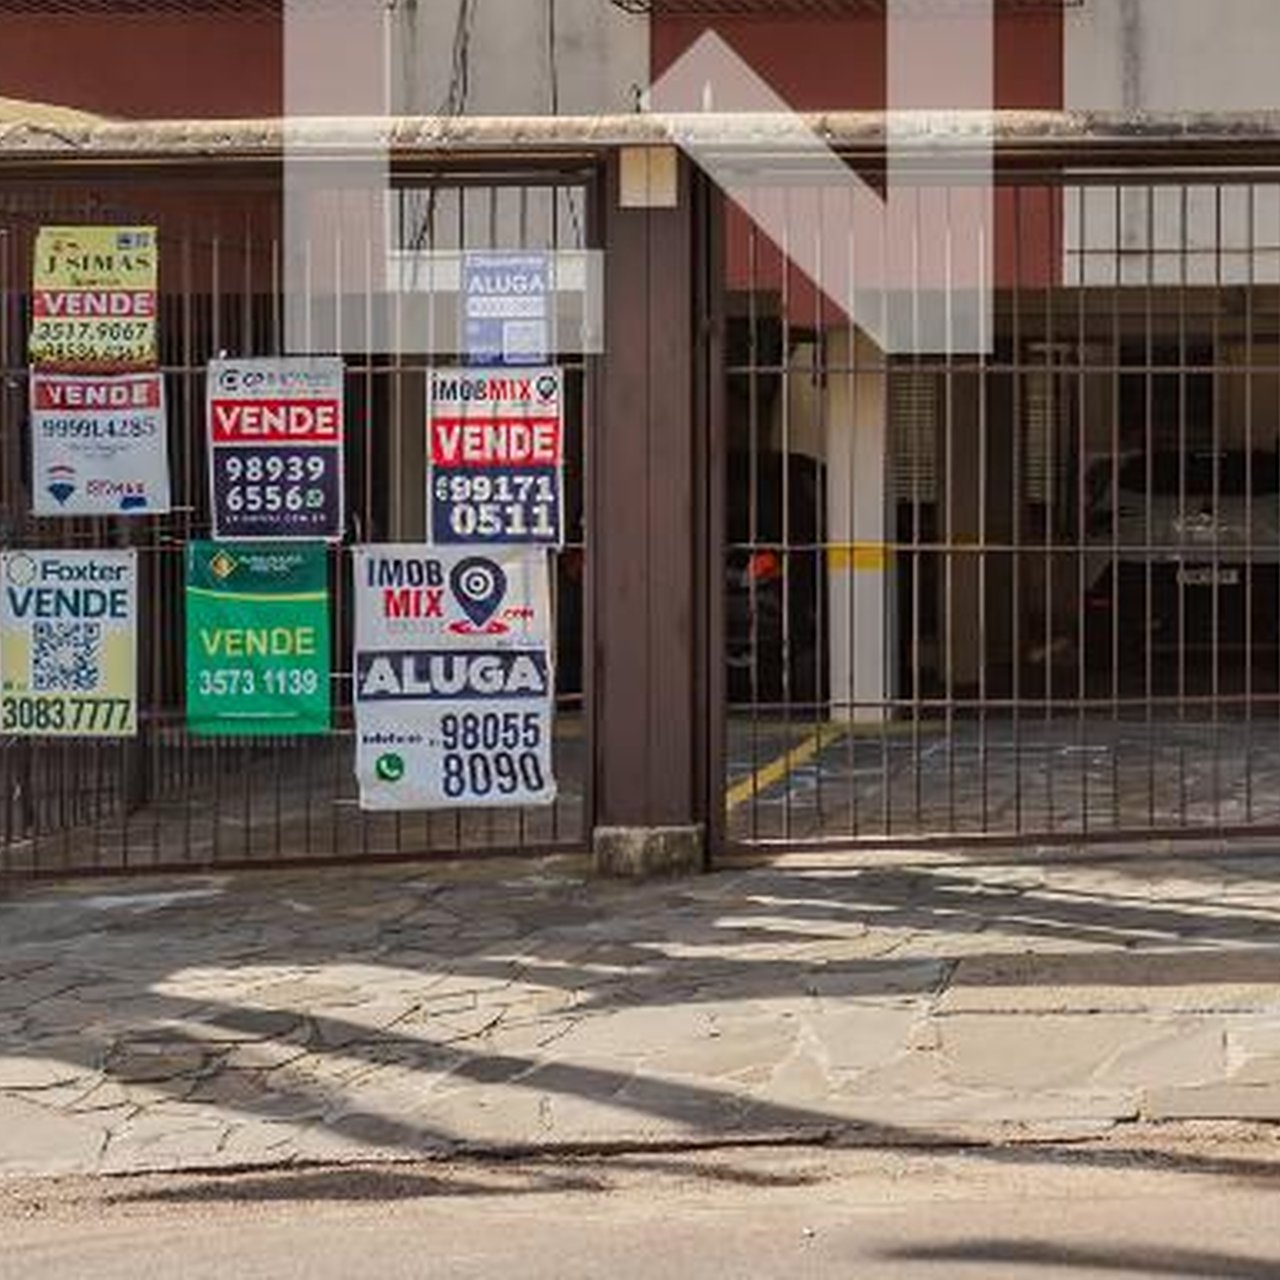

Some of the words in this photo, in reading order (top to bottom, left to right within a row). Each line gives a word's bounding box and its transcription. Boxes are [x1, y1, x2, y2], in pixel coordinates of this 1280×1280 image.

[468, 274, 545, 294] ALUGA
[43, 292, 152, 315] VENDE
[46, 384, 149, 405] VENDE
[215, 405, 335, 436] VENDE
[436, 423, 554, 461] VENDE
[225, 455, 326, 481] 98939
[225, 485, 303, 511] 6556
[450, 475, 554, 502] 99171
[450, 503, 554, 536] 0511
[41, 559, 128, 581] Foxter
[367, 559, 444, 588] IMOB
[7, 587, 128, 618] VENDE
[383, 589, 444, 619] MIX
[200, 627, 316, 656] VENDE
[199, 669, 256, 695] 3573
[263, 669, 318, 695] 1139
[361, 655, 545, 695] ALUGA
[440, 712, 540, 750] 98055
[442, 752, 545, 797] 8090
